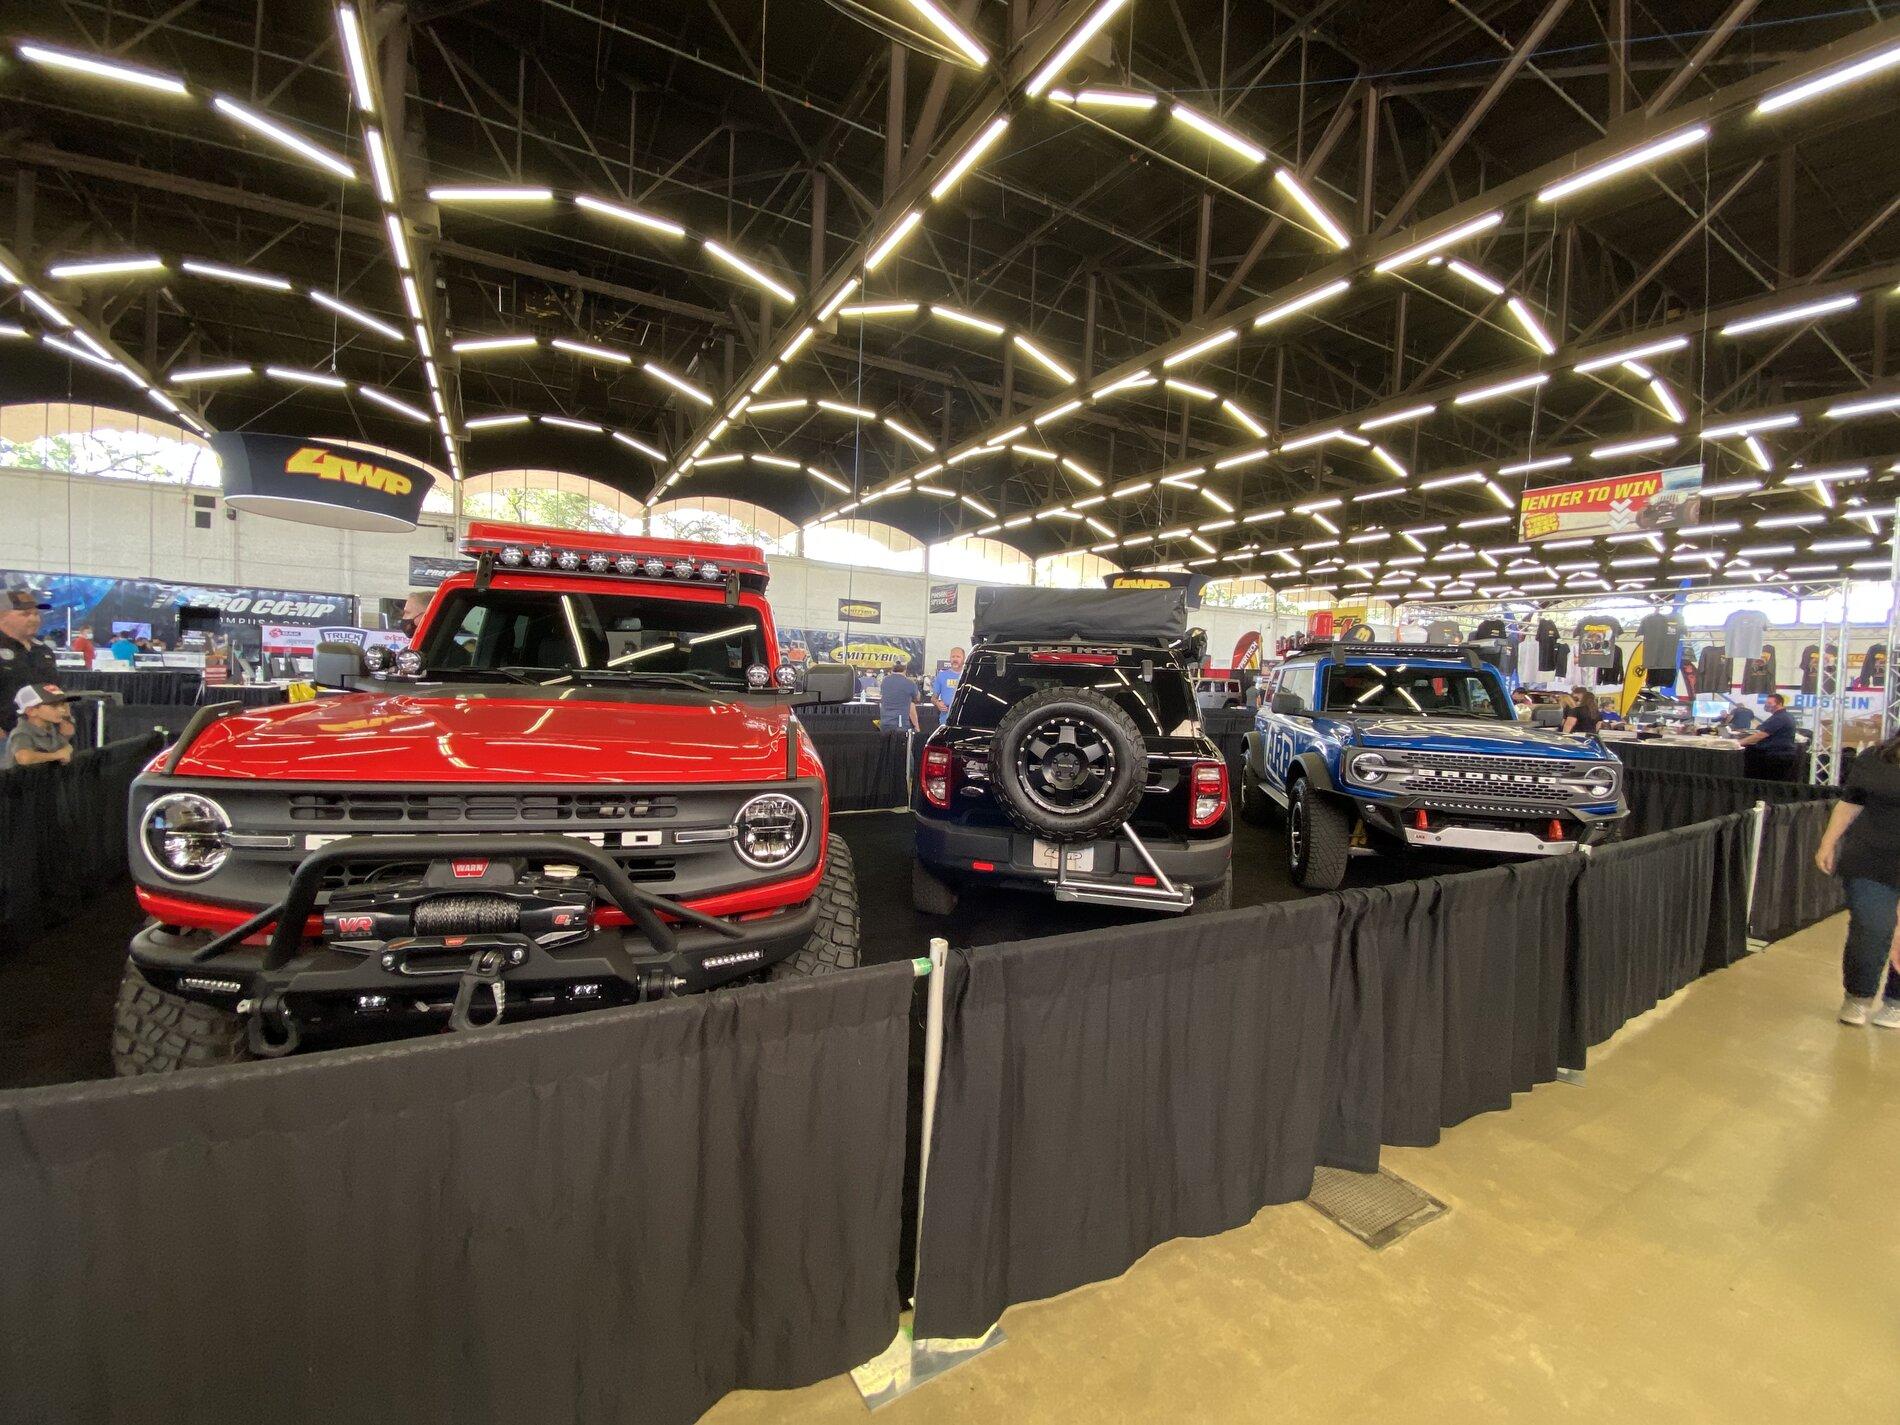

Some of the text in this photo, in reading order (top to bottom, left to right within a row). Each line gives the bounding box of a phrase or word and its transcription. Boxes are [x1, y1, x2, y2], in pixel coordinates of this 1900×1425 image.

[286, 448, 412, 495] 4WP
[1529, 479, 1657, 511] ENTER TO WIN
[327, 632, 360, 640] TRUCK
[837, 651, 906, 662] SMITTYBI
[1418, 769, 1557, 784] BRONCO
[456, 863, 483, 873] WARN
[338, 917, 373, 932] VR
